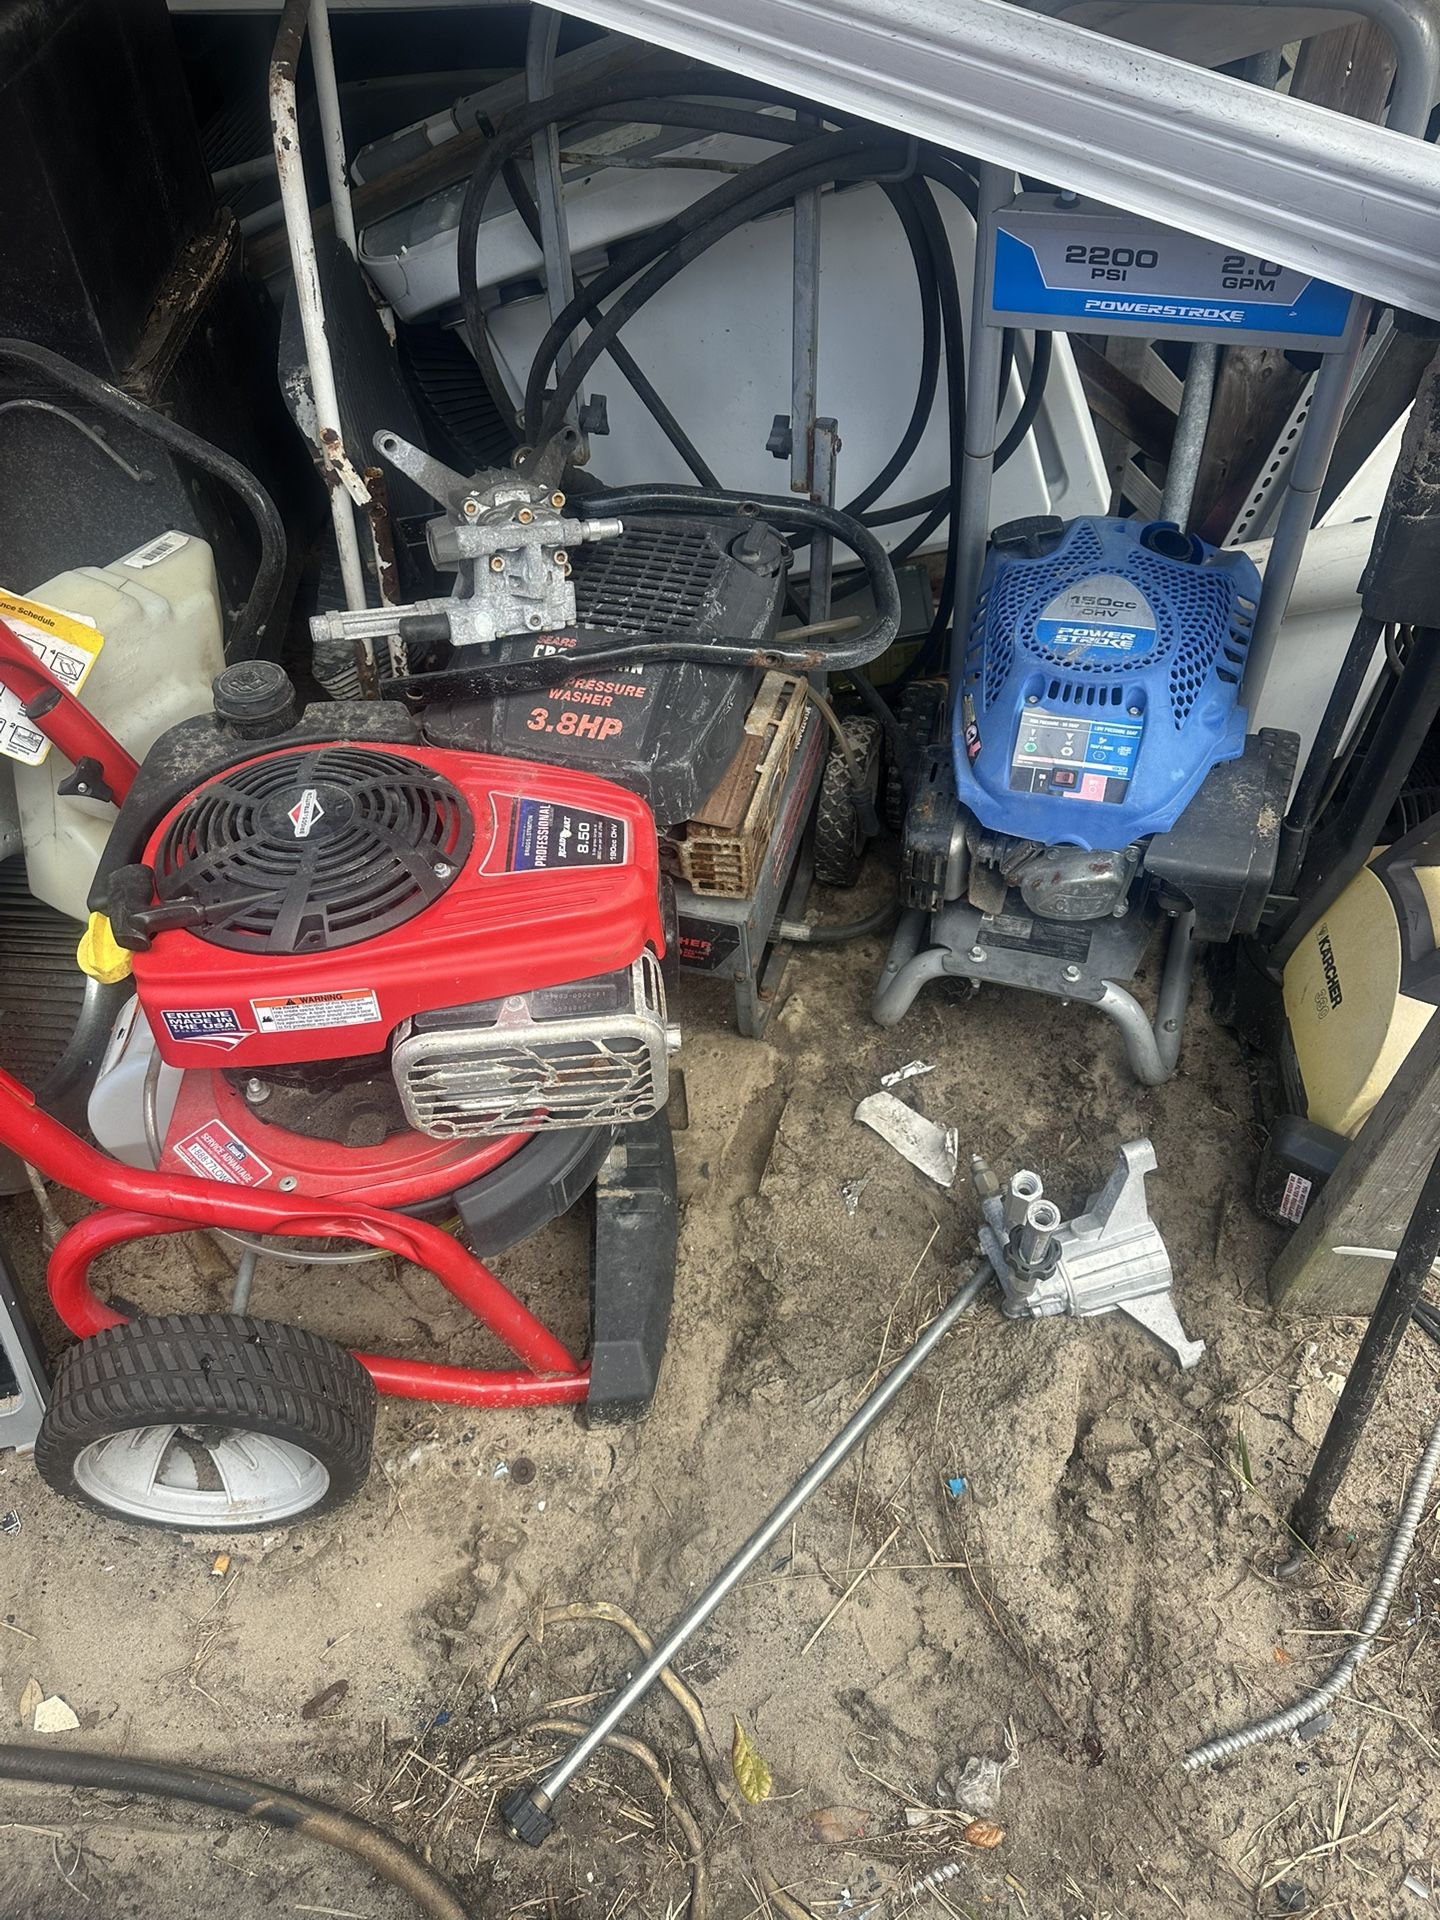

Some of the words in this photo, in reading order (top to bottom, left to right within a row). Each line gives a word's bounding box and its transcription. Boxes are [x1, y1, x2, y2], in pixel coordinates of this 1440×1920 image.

[1065, 244, 1158, 269] 2200
[1221, 256, 1283, 278] 2.0
[1090, 268, 1127, 282] PSI
[1222, 277, 1276, 292] GPM
[1084, 299, 1246, 323] POWERSTROKE
[1071, 595, 1138, 609] 150cc
[17, 606, 56, 627] Schedule
[1082, 609, 1118, 618] OHV
[536, 635, 577, 648] SEARS
[1053, 635, 1135, 650] STROKE
[1058, 627, 1136, 640] POWER
[549, 688, 614, 706] WASHER
[527, 708, 623, 740] 3.8HP
[534, 804, 551, 866] PROFESSIONAL
[577, 822, 590, 854] 8.50
[300, 993, 343, 1004] WARNING
[201, 1133, 224, 1155] SERVICE
[222, 1152, 254, 1184] ADVANTAGE
